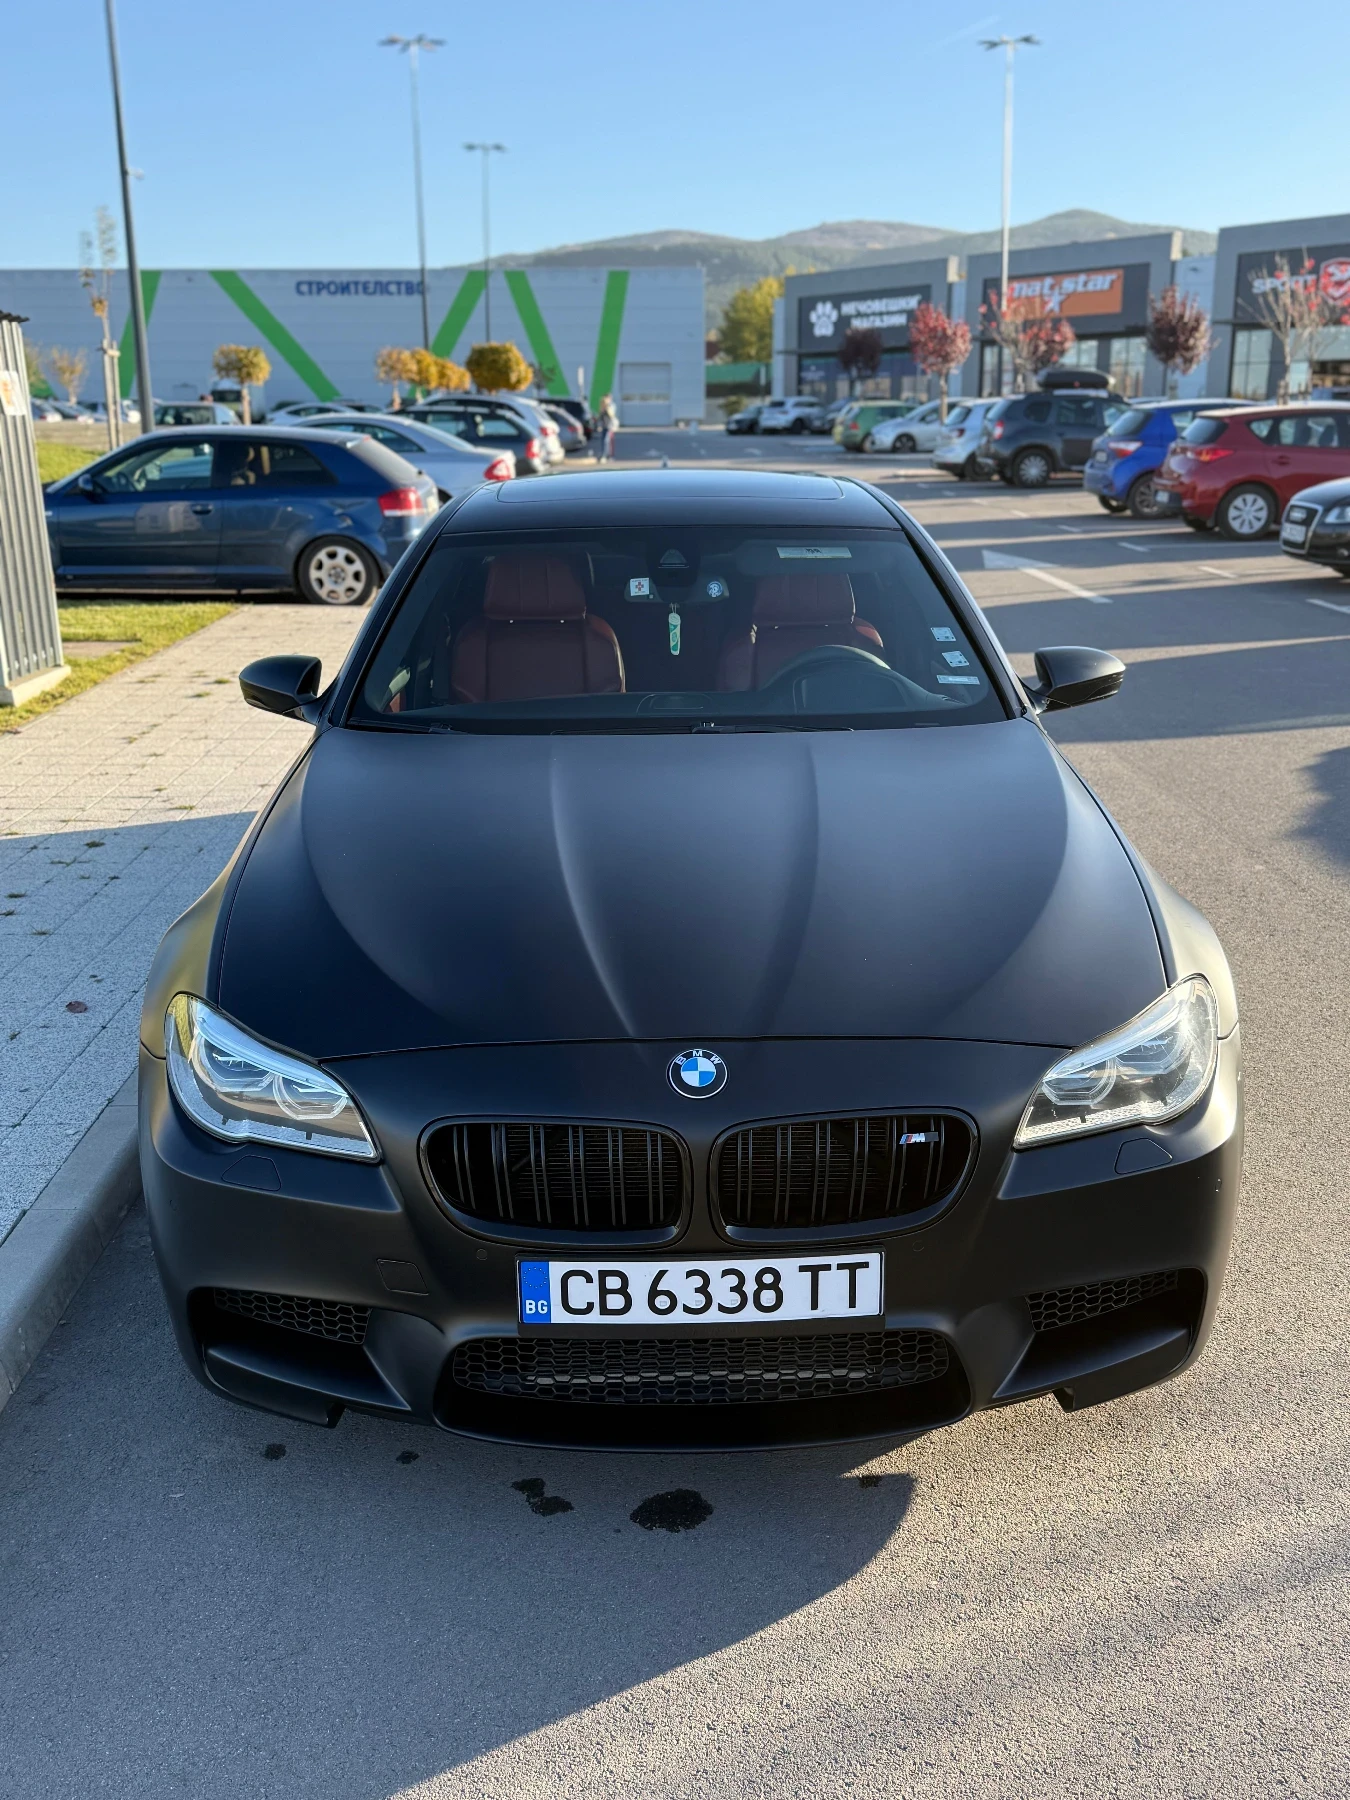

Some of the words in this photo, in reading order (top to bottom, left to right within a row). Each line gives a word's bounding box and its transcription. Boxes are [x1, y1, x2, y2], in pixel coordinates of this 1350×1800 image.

[1061, 273, 1117, 293] star
[674, 1050, 722, 1065] BMW
[560, 1269, 633, 1316] CB
[647, 1266, 784, 1316] 6338
[798, 1261, 870, 1311] TT
[525, 1300, 548, 1314] BG
